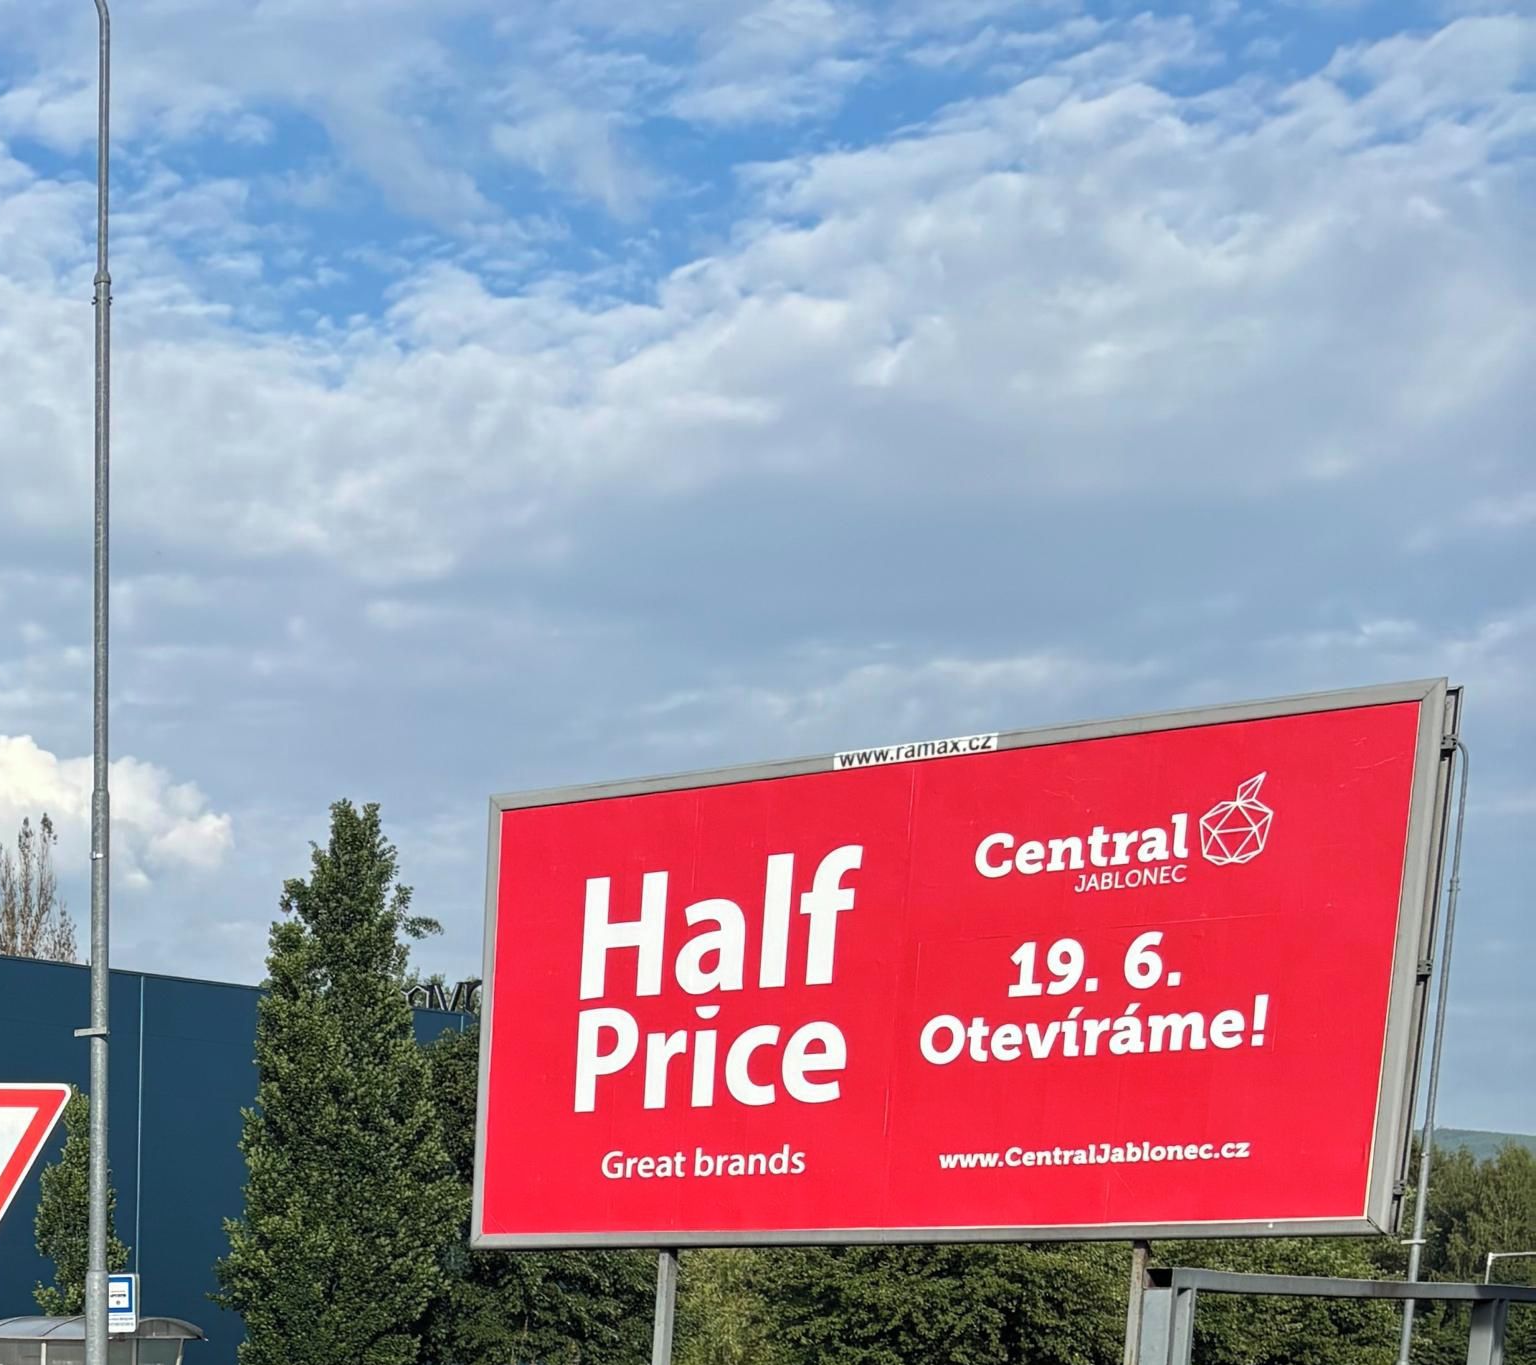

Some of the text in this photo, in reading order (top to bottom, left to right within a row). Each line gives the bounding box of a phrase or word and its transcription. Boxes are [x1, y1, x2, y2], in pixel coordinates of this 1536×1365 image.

[840, 735, 992, 768] www.ramax.cz
[974, 812, 1189, 878] Central
[1074, 864, 1188, 893] JABLONEC
[579, 844, 864, 1001] Half
[1007, 931, 1182, 998] 19. 6.
[574, 1004, 848, 1113] Price
[919, 993, 1270, 1065] Otevíráme!
[600, 1143, 806, 1179] Great brands
[939, 1141, 1251, 1169] www.CentralJablonec.cz
